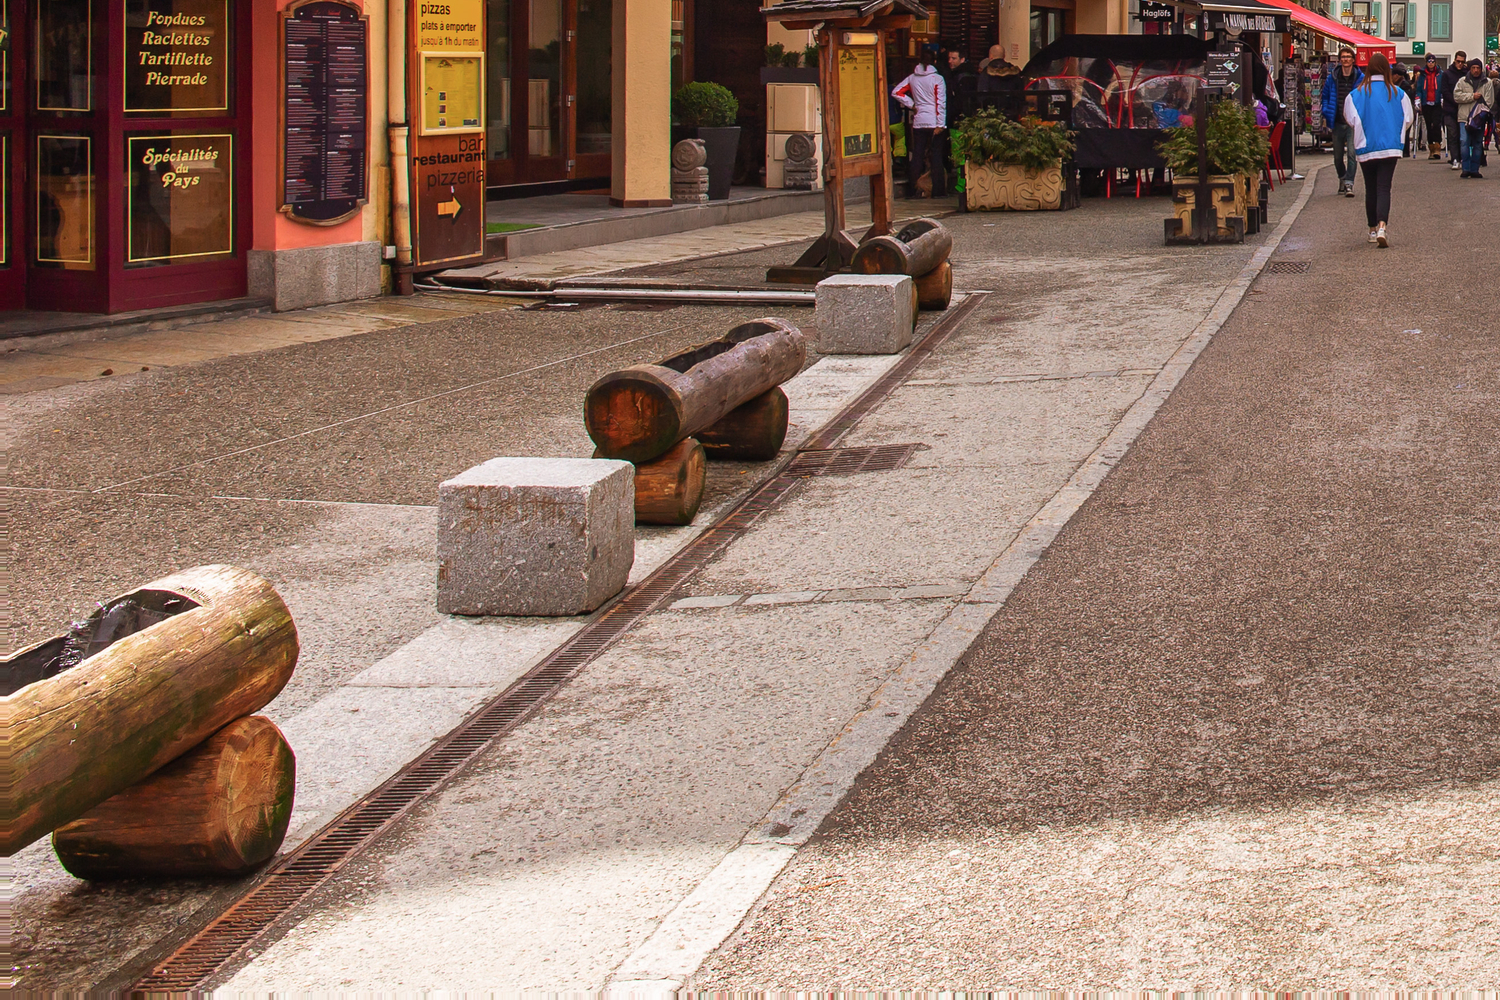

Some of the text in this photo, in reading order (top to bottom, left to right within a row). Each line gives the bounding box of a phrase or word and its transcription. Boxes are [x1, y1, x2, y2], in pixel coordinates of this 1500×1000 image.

[421, 1, 451, 17] pizzas
[1142, 9, 1171, 18] Haglöfs
[146, 11, 206, 27] Fondues
[421, 20, 477, 33] plats à emporter
[1255, 15, 1276, 31] BURGERS
[142, 31, 210, 46] Raclettes
[444, 36, 453, 46] 1h
[462, 36, 480, 47] matin
[139, 51, 213, 66] Tartiflette
[145, 72, 208, 86] Pierrade
[458, 136, 484, 152] bar
[142, 146, 219, 165] Spécialités
[413, 150, 486, 167] restaurant
[175, 163, 189, 174] du
[161, 172, 200, 189] Pays
[427, 167, 485, 191] pizzeria
